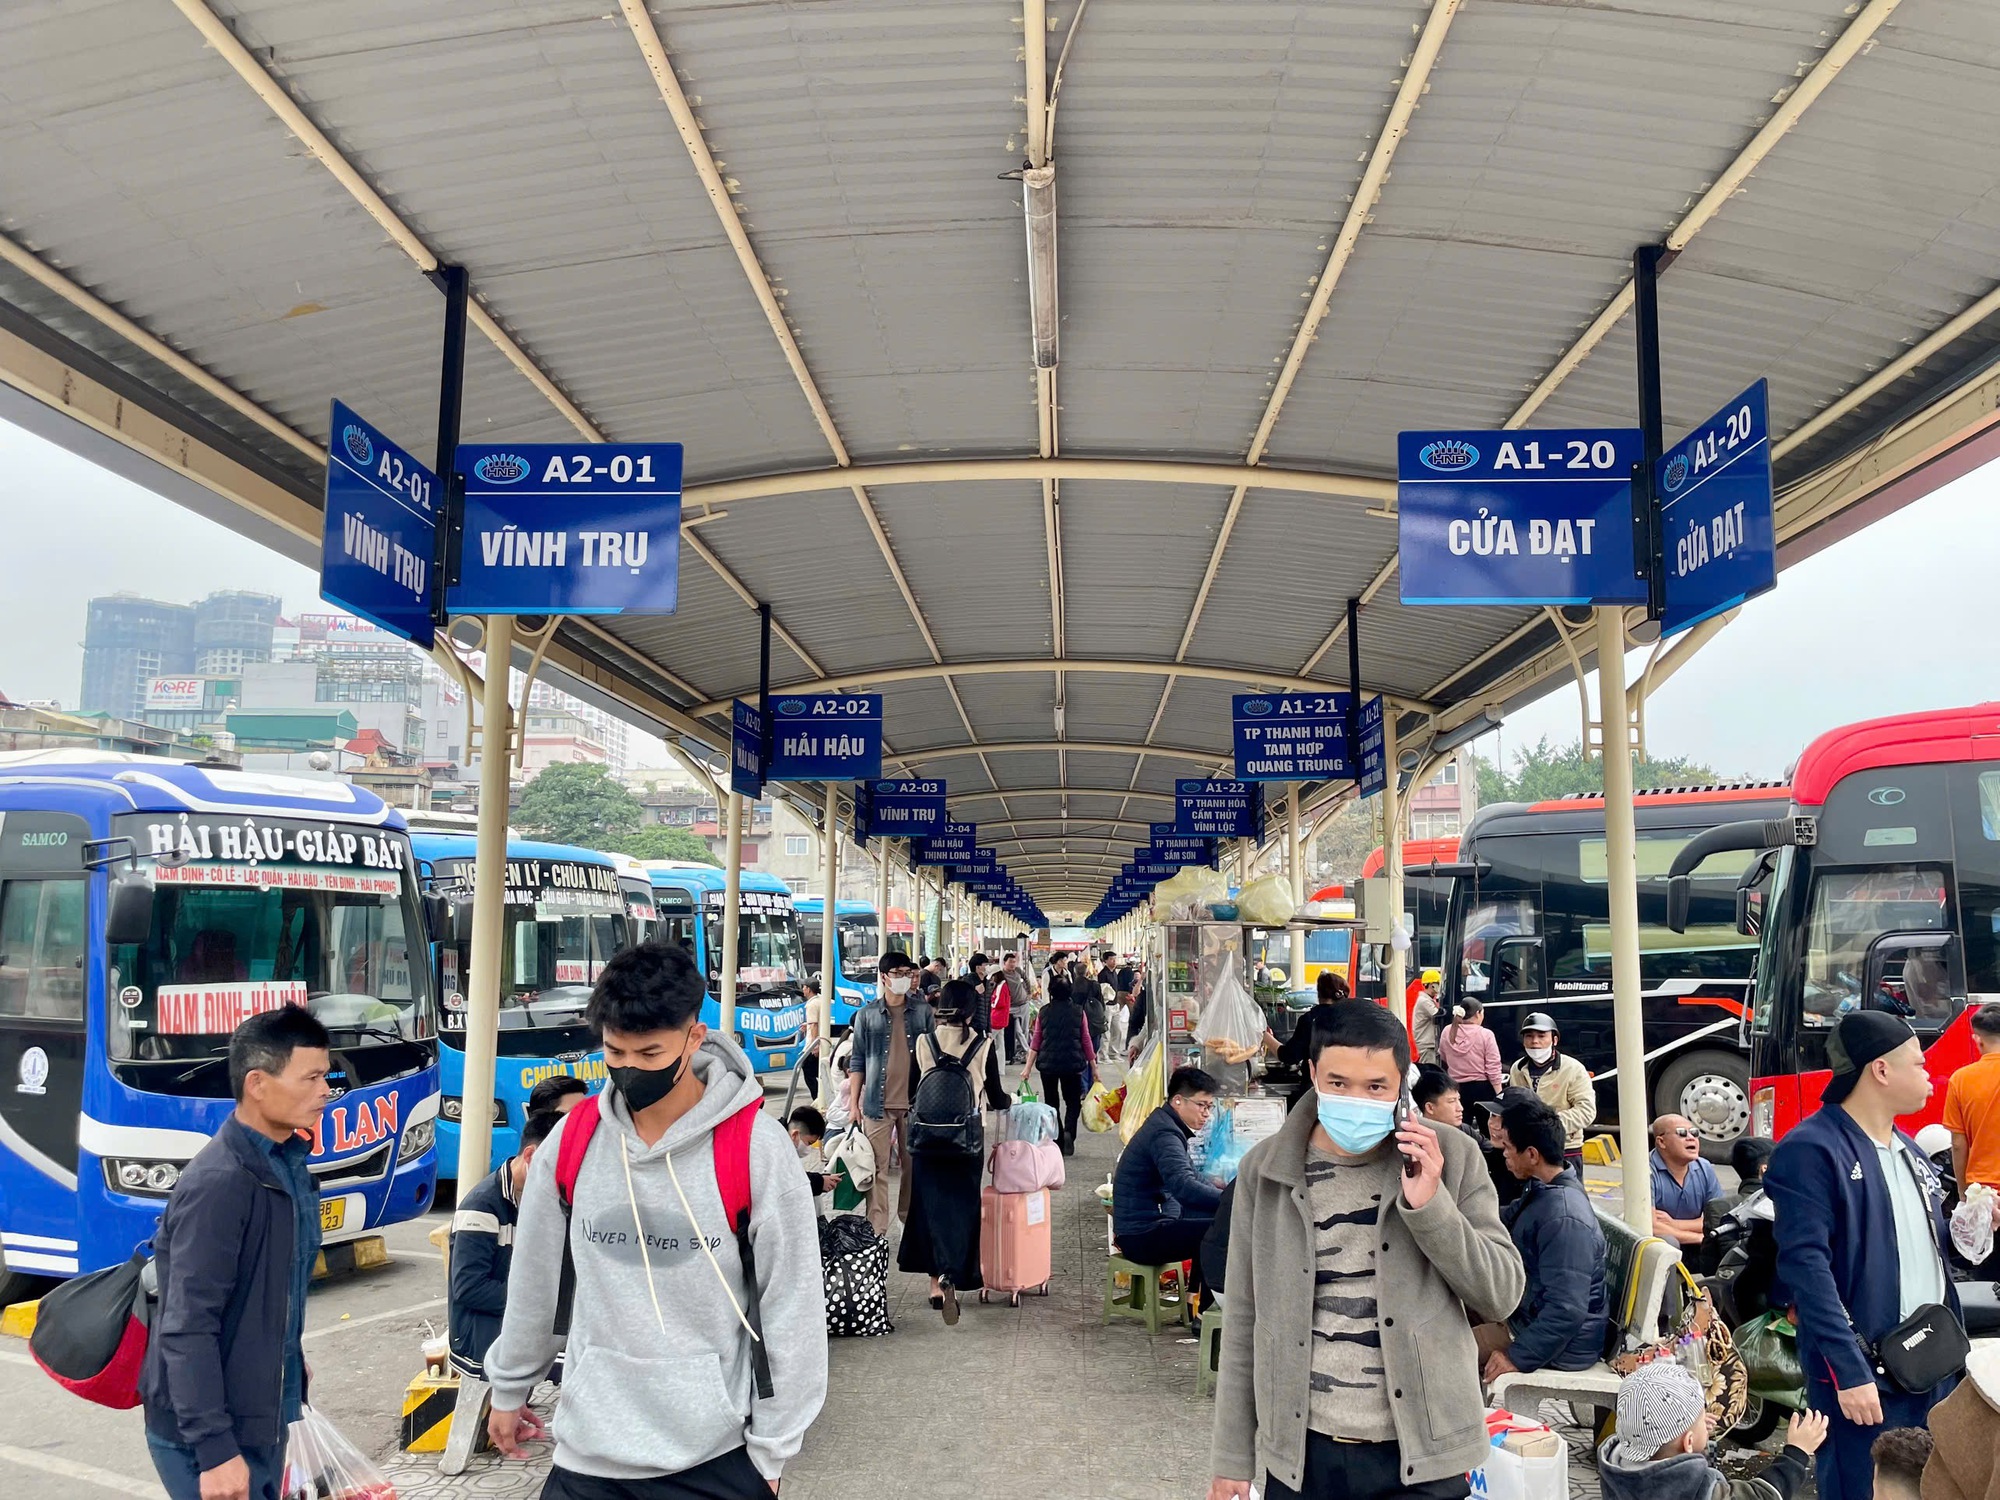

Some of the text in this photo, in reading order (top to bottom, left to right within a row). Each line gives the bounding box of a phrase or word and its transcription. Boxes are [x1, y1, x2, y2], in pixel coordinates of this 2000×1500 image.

[1694, 404, 1751, 474] A1-20
[1432, 453, 1467, 465] HNB
[1493, 440, 1616, 470] A1-20
[485, 467, 518, 478] HNB
[541, 455, 656, 483] A2-01
[378, 450, 431, 511] A2-01
[1448, 507, 1596, 563] CỬA ĐẠT
[1677, 500, 1744, 577] CỬA ĐẠT
[344, 511, 426, 603] VĨNH TRỤ
[480, 524, 649, 575] VĨNH TRỤ
[812, 700, 870, 715] A2-02
[1279, 698, 1338, 714] A1-21
[1244, 722, 1343, 740] TP THANH HOÁ
[784, 732, 865, 760] HẢI HẬU
[1264, 741, 1324, 757] TAM HỢP
[1246, 759, 1344, 774] QUANG TRUNG
[899, 783, 938, 793] A2-03
[1205, 783, 1245, 793] A1-22
[1182, 799, 1193, 808] TP
[1195, 799, 1226, 808] THANH
[879, 806, 936, 824] VĨNH TRỤ
[22, 832, 68, 846] SAMCO
[147, 812, 213, 859] HẢI
[362, 831, 403, 870] BÁT
[931, 837, 964, 849] HẢI HẬU
[949, 851, 971, 860] LONG
[155, 866, 178, 881] NAM
[181, 867, 204, 884] ĐỊNH
[525, 860, 542, 886] LÝ
[551, 863, 588, 889] CHÙA
[588, 866, 619, 893] VÀNG
[503, 888, 517, 904] ÒA
[759, 997, 782, 1009] QUANG
[159, 992, 200, 1034] NAM
[741, 1011, 771, 1032] GIAO
[331, 1090, 399, 1153] LAN
